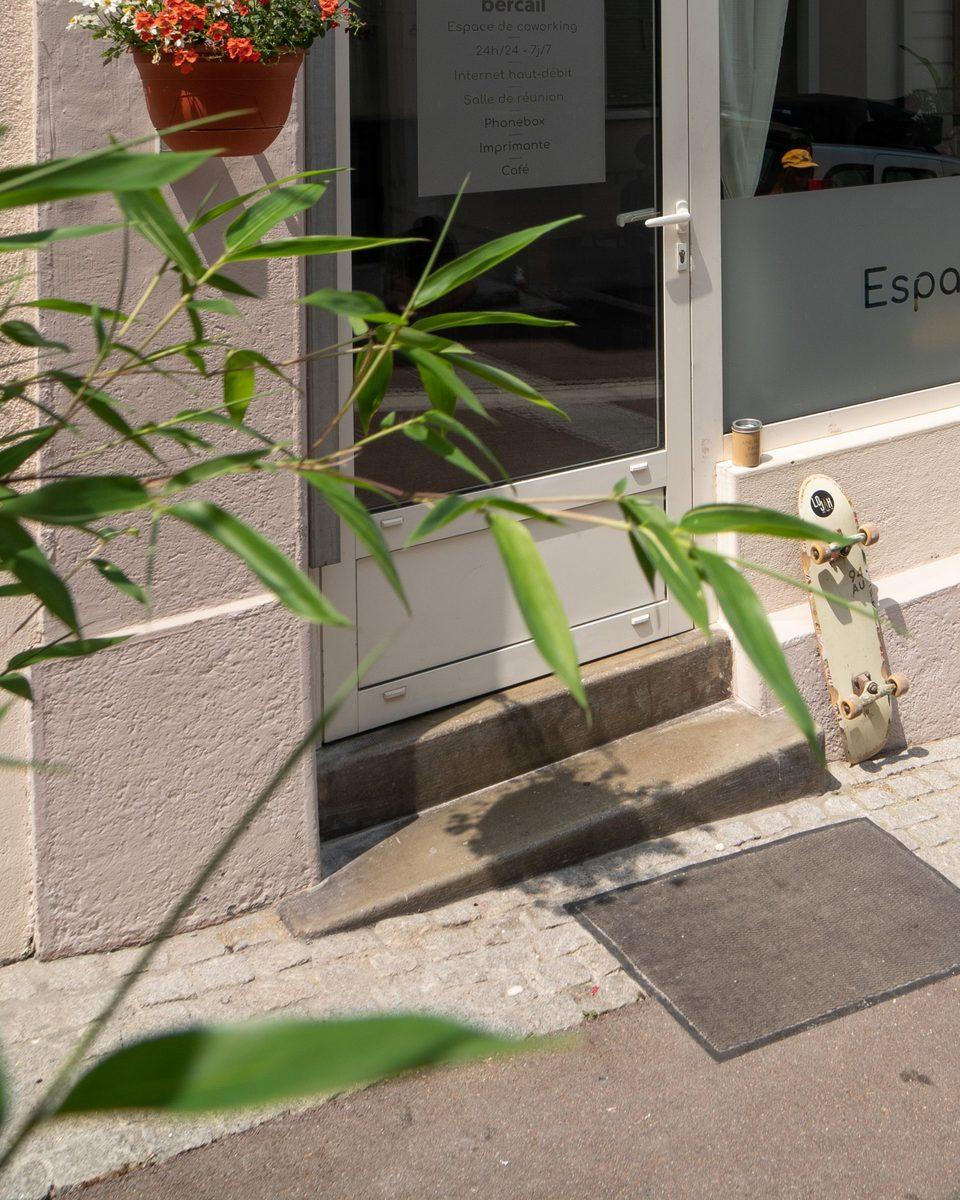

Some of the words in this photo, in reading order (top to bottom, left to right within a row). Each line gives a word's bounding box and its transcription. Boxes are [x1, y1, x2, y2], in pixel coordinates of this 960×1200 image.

[447, 20, 494, 34] Espace
[497, 20, 513, 32] de
[517, 20, 577, 34] coworking
[475, 44, 519, 56] 24h/24
[454, 69, 504, 81] Internet
[464, 93, 495, 105] Salle
[498, 93, 514, 104] de
[517, 90, 564, 104] réunion
[484, 116, 545, 129] Phonebox
[479, 140, 551, 154] Imprimante
[501, 163, 530, 176] Café
